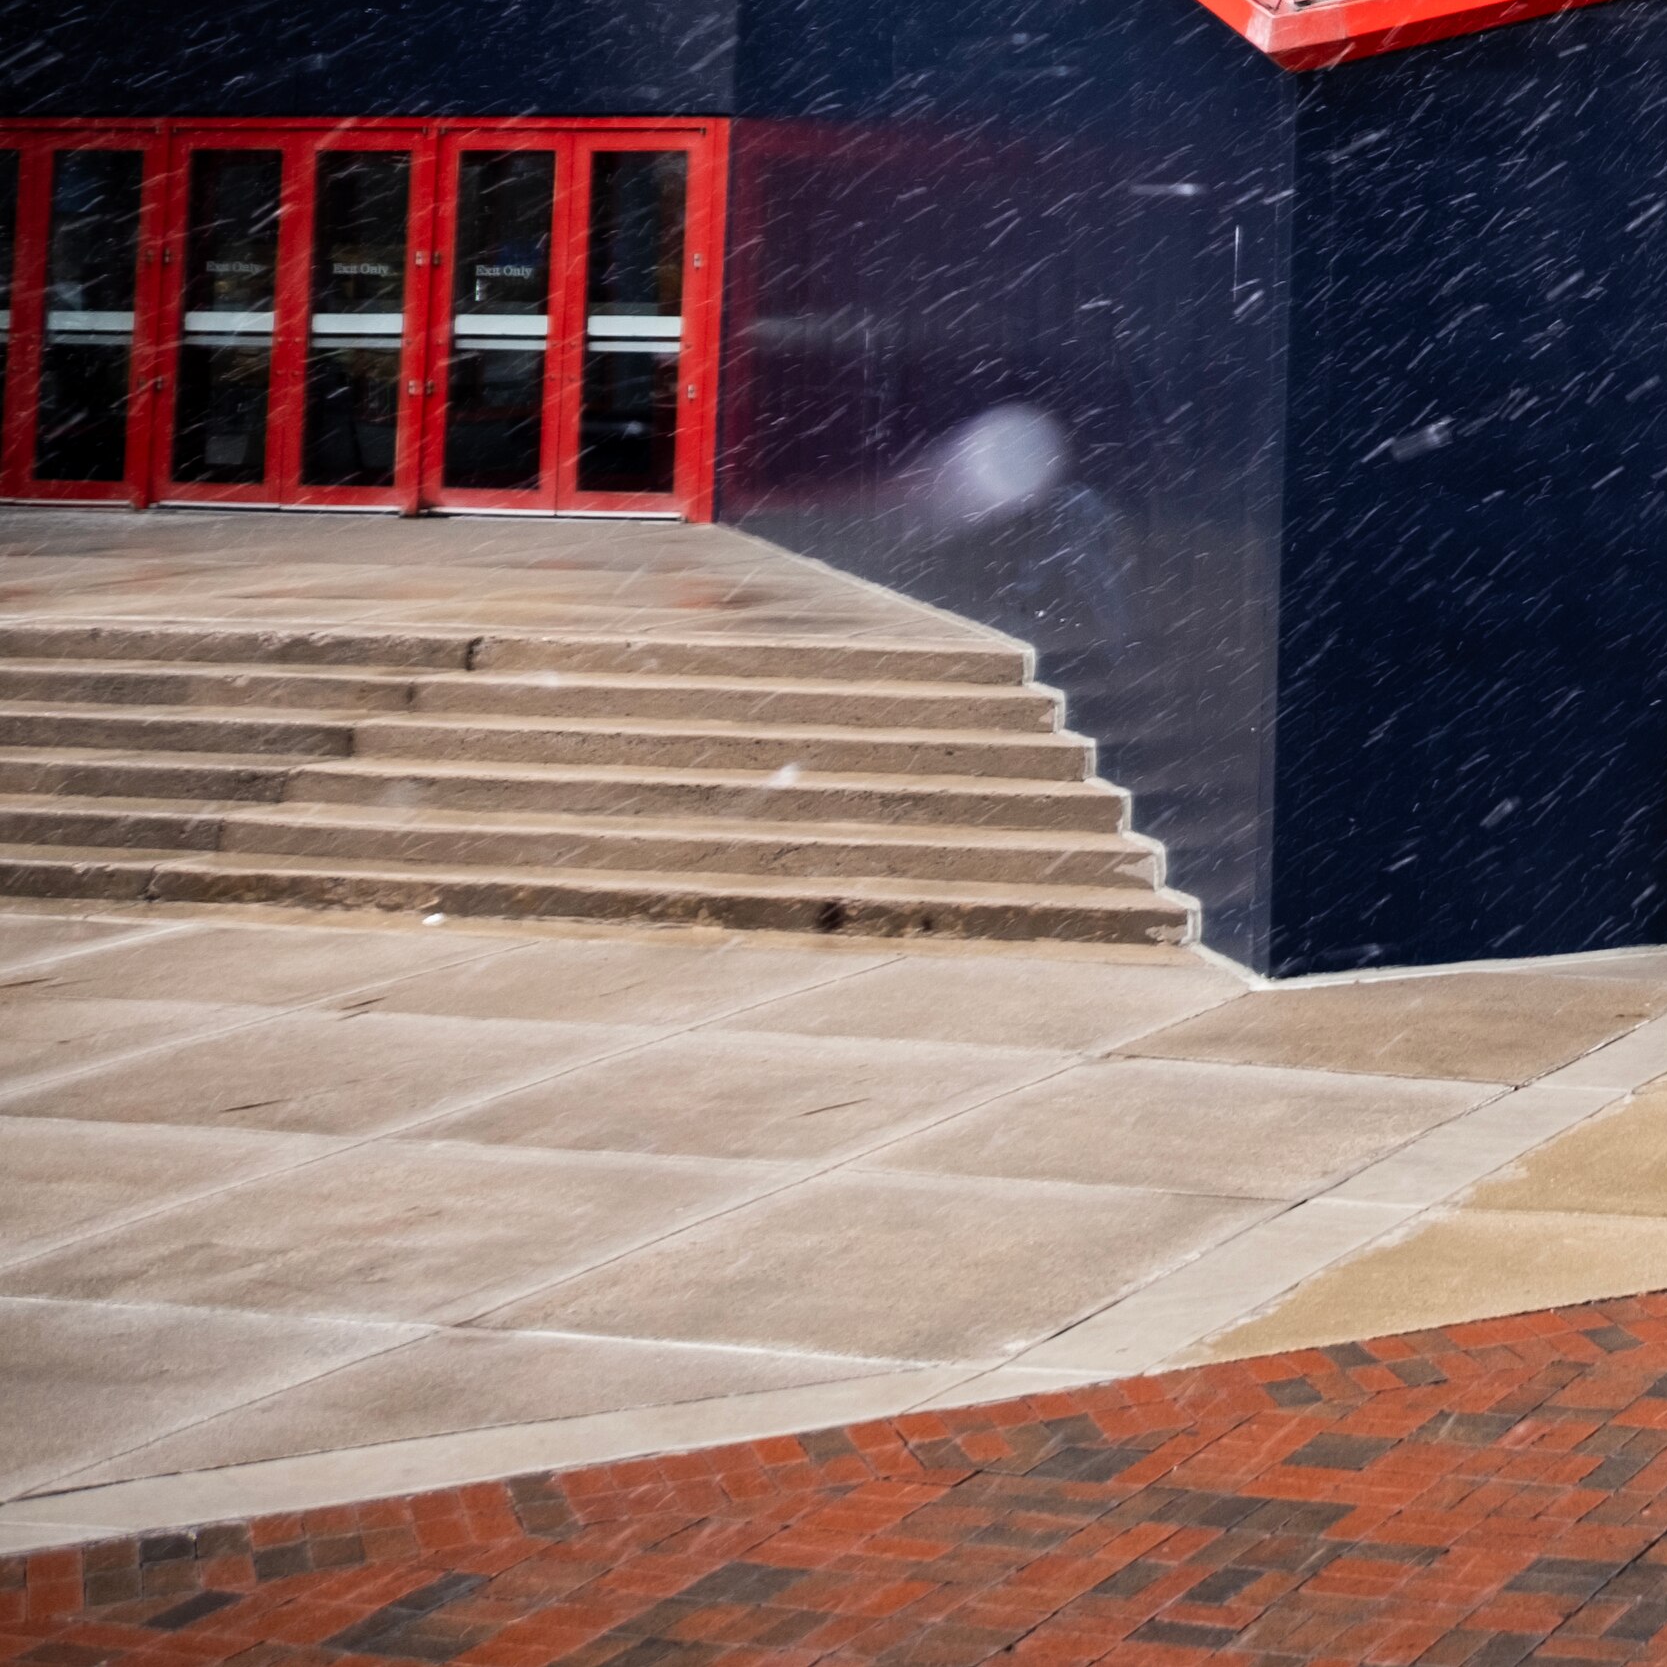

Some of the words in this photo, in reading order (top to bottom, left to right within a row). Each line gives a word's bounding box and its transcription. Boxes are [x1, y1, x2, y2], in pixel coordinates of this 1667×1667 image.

[333, 263, 357, 274] Exit
[359, 263, 389, 277] Only
[475, 265, 500, 276] Exit
[503, 265, 533, 279] Only
